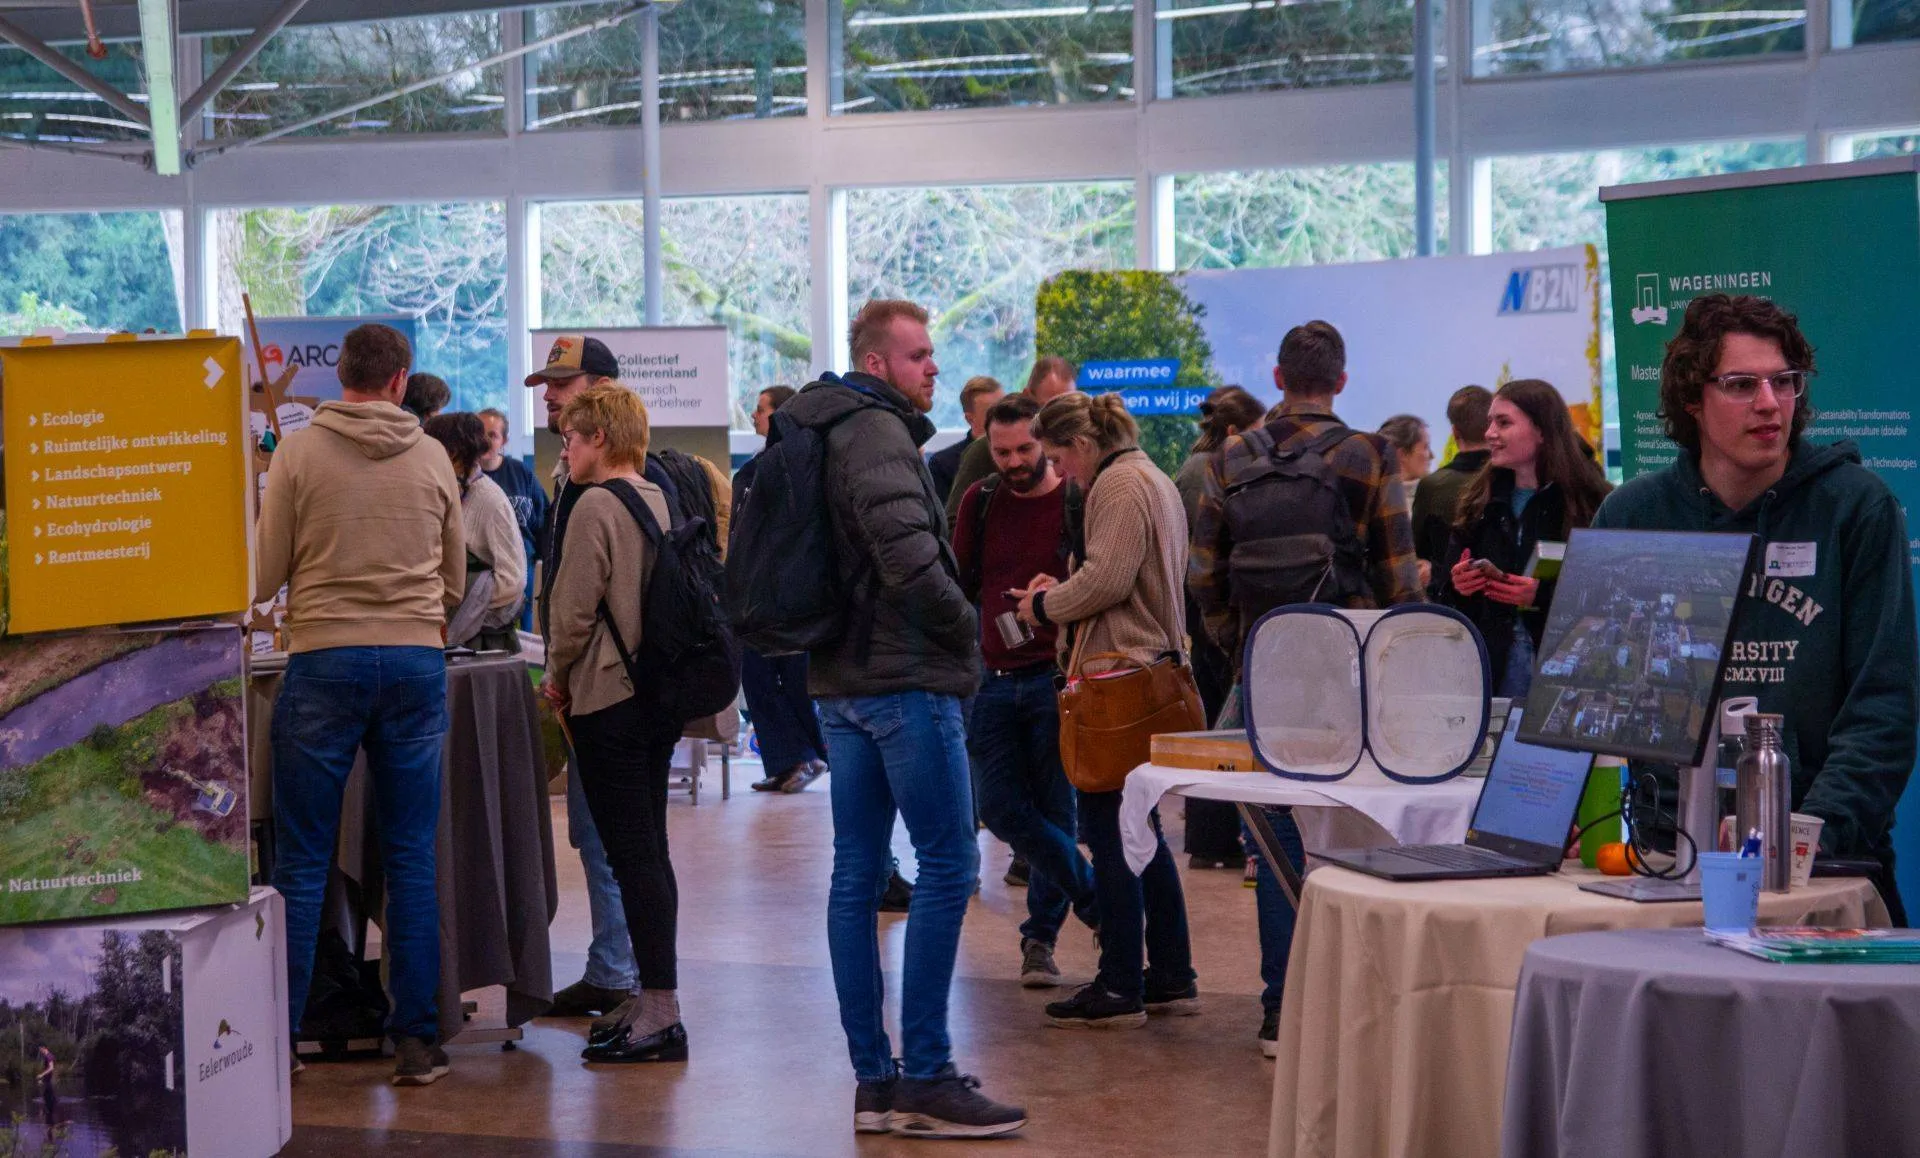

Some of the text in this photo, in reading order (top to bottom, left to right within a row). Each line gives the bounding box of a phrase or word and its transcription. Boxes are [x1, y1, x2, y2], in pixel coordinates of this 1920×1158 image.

[1669, 271, 1772, 291] WAGENINGEN
[617, 353, 680, 366] Collectief
[619, 367, 698, 378] Rivierenland
[1087, 365, 1171, 380] waarmee
[1154, 390, 1180, 411] wij
[42, 409, 105, 427] Ecologie
[43, 435, 129, 454] Ruimtelijke
[131, 428, 228, 448] ontwikkeling
[44, 459, 192, 482] Landschapsontwerp
[46, 487, 162, 509] Natuurtechniek
[47, 515, 153, 537] Ecohydrologie
[48, 541, 151, 564] Rentmeesterij
[1731, 640, 1800, 662] RSITY
[8, 866, 143, 893] Natuurtechniek
[198, 1040, 254, 1082] Eelerwoude
